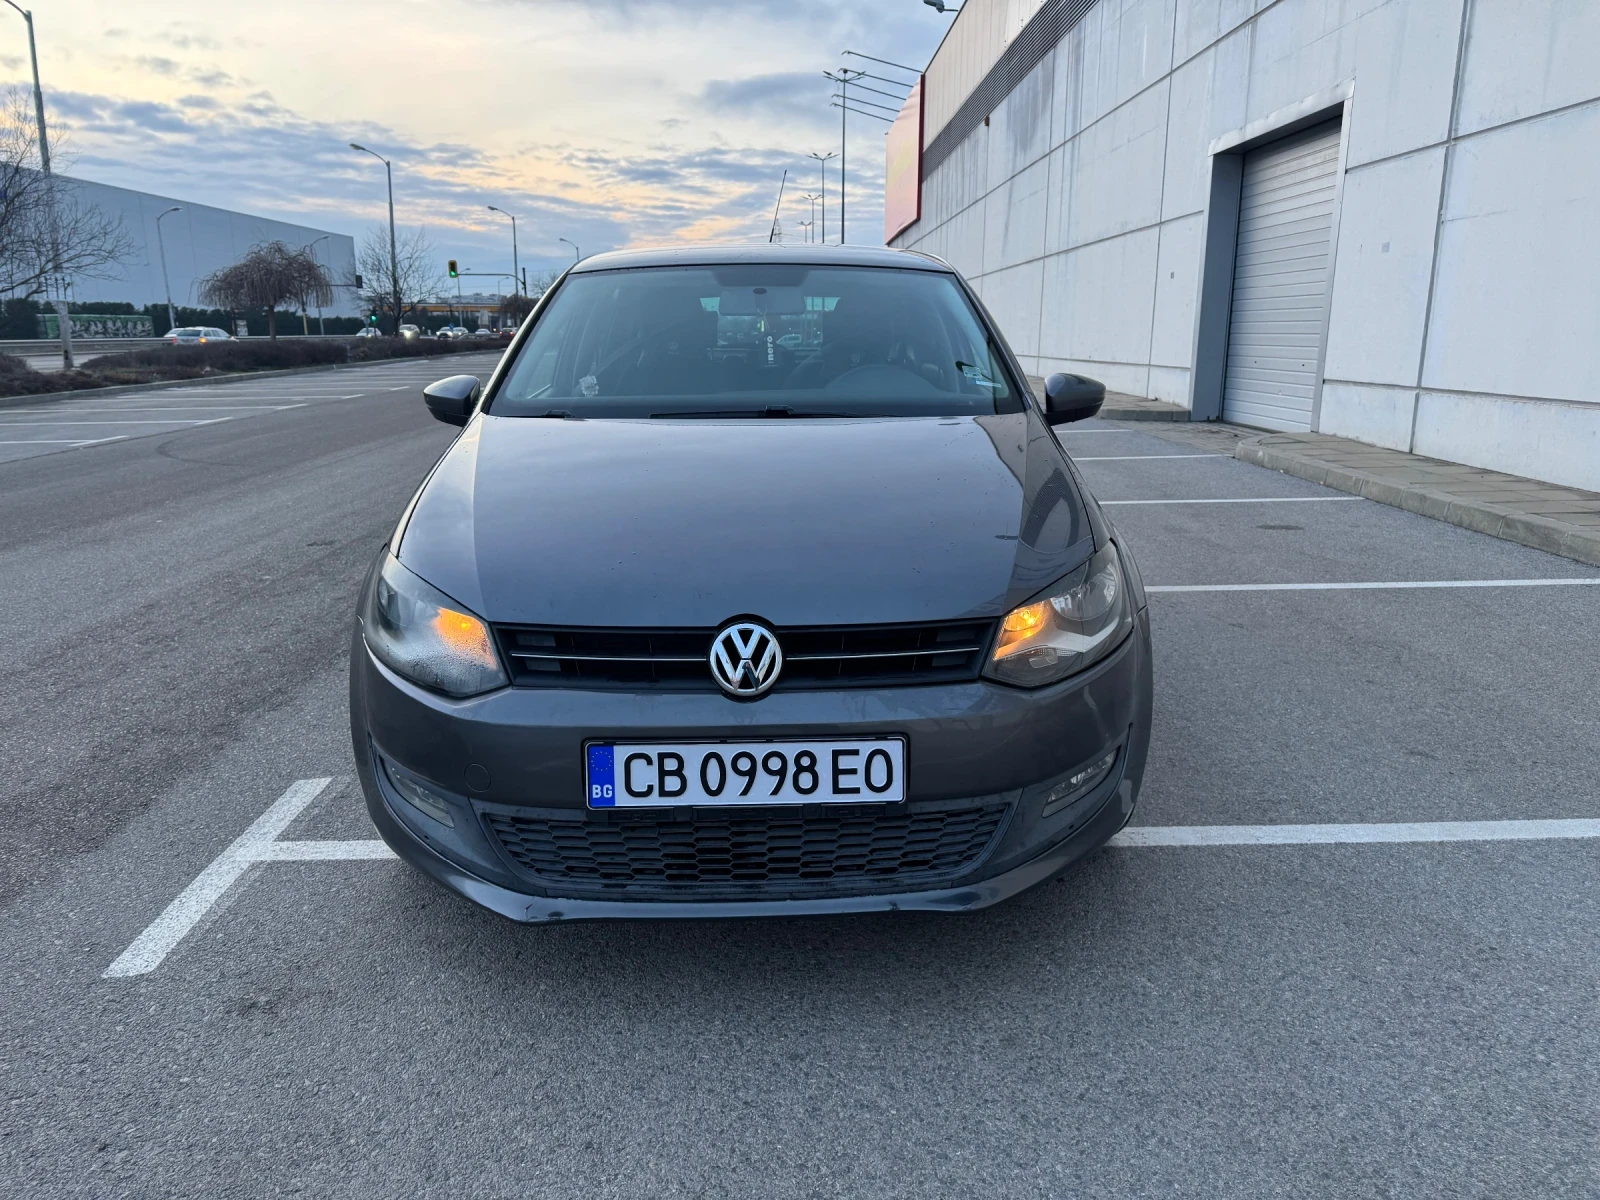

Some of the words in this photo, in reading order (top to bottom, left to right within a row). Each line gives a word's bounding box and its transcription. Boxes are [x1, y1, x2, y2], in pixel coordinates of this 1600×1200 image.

[710, 624, 783, 696] VW
[592, 785, 613, 798] BG
[623, 751, 688, 797] CB
[699, 749, 819, 796] 0998
